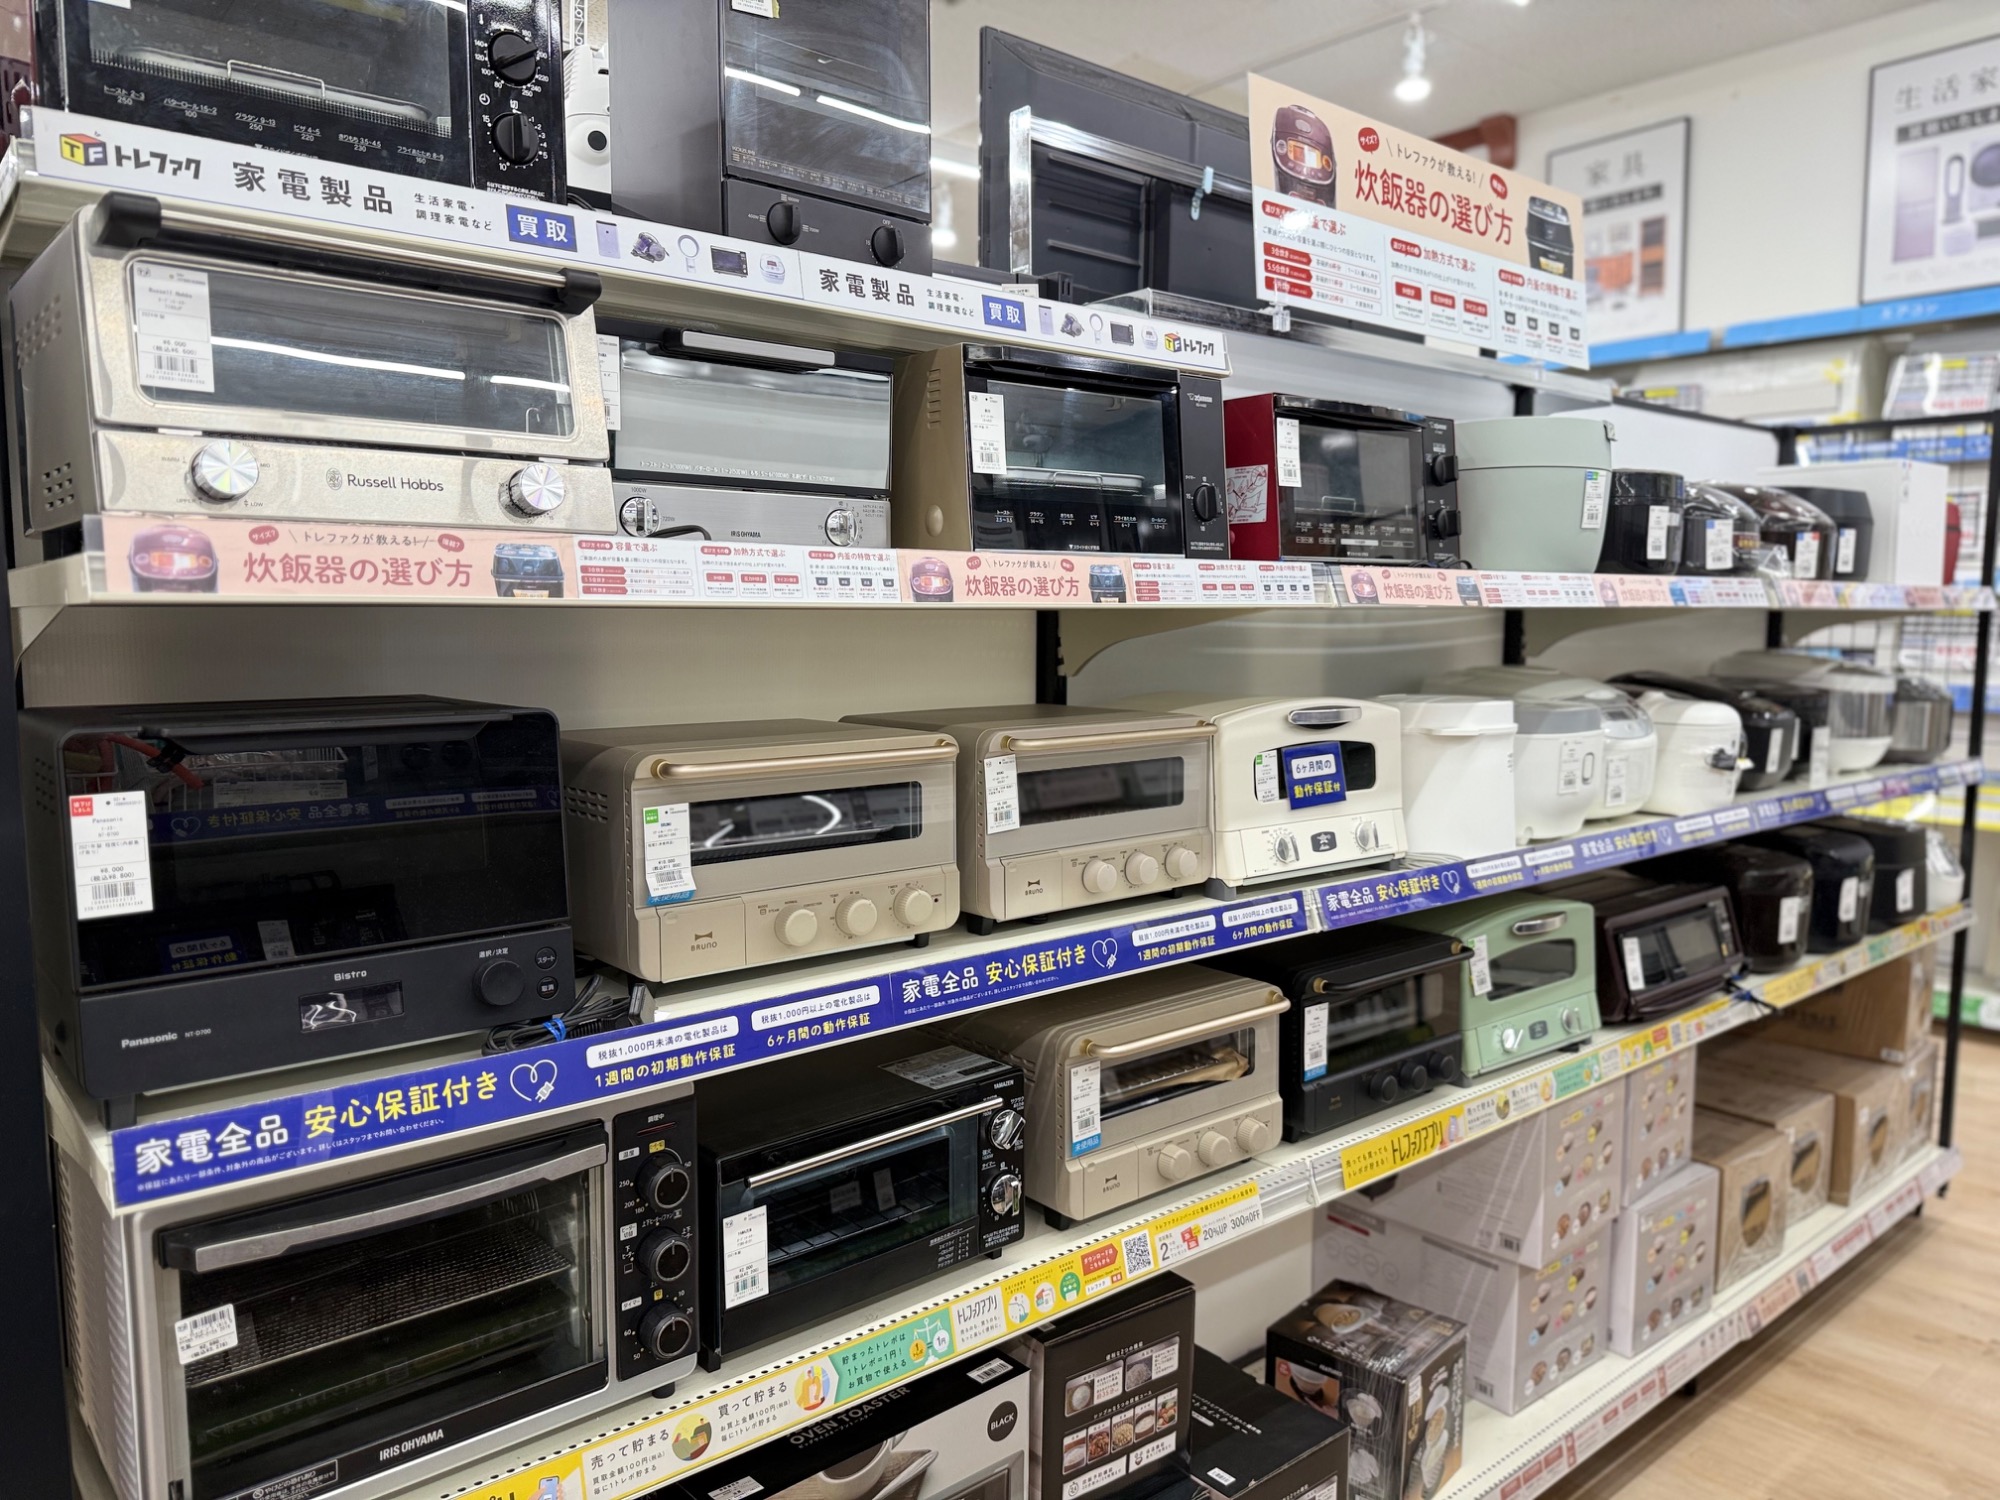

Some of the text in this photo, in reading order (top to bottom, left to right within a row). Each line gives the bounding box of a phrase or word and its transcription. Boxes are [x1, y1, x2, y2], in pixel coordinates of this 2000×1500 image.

[498, 162, 508, 171] 10
[232, 161, 393, 215] 家電製品
[1354, 160, 1514, 246] 炊飯器の選び方
[416, 208, 493, 232] 調理家電など
[517, 213, 569, 244] 買取
[818, 268, 915, 308] 家電製品
[988, 301, 1022, 325] 買取
[346, 474, 444, 492] Russell Hobbs
[730, 530, 740, 538] IRIS
[243, 552, 473, 588] 炊飯器の選び方
[965, 574, 1080, 598] 炊飯器の選び方
[1296, 760, 1332, 774] 6ヶ月間の
[1024, 887, 1044, 896] BRUNO
[1326, 874, 1440, 912] 家電全品 安心保証付き
[690, 940, 718, 952] BRUNO
[334, 969, 367, 982] Bistro
[902, 944, 1086, 1004] 家電全品 安心保証付き
[760, 992, 871, 1026] 税抜1,000円以上の電化製品は
[121, 1032, 178, 1050] Panasonic
[598, 1024, 728, 1061] 税抜1,000円未満の電化製品は
[766, 1012, 871, 1048] 6ヶ月間の動作保証
[594, 1044, 736, 1088] 1週間の初期動作保証
[994, 1080, 1014, 1090] YAMAZEN
[135, 1070, 498, 1176] 家電全品 安心保証付き
[1392, 1120, 1444, 1165] トレファクアプリ
[619, 1180, 630, 1188] 250
[624, 1200, 636, 1208] 200
[635, 1206, 645, 1214] 180
[1160, 1242, 1170, 1262] 2
[956, 1294, 999, 1326] トレファクアプリ
[624, 1328, 632, 1337] 60
[633, 1352, 641, 1360] 50
[842, 1332, 906, 1366] 貯まったトレポは
[848, 1360, 908, 1390] お買物で使える
[718, 1381, 788, 1420] 買って貯まる
[790, 1386, 911, 1444] OVEN TOASTER
[990, 1412, 1015, 1431] BLACK
[378, 1428, 444, 1462] IRIS OHYAMA
[590, 1428, 670, 1471] 売って貯まる
[594, 1464, 658, 1496] 毎に1トレポ貯まる
